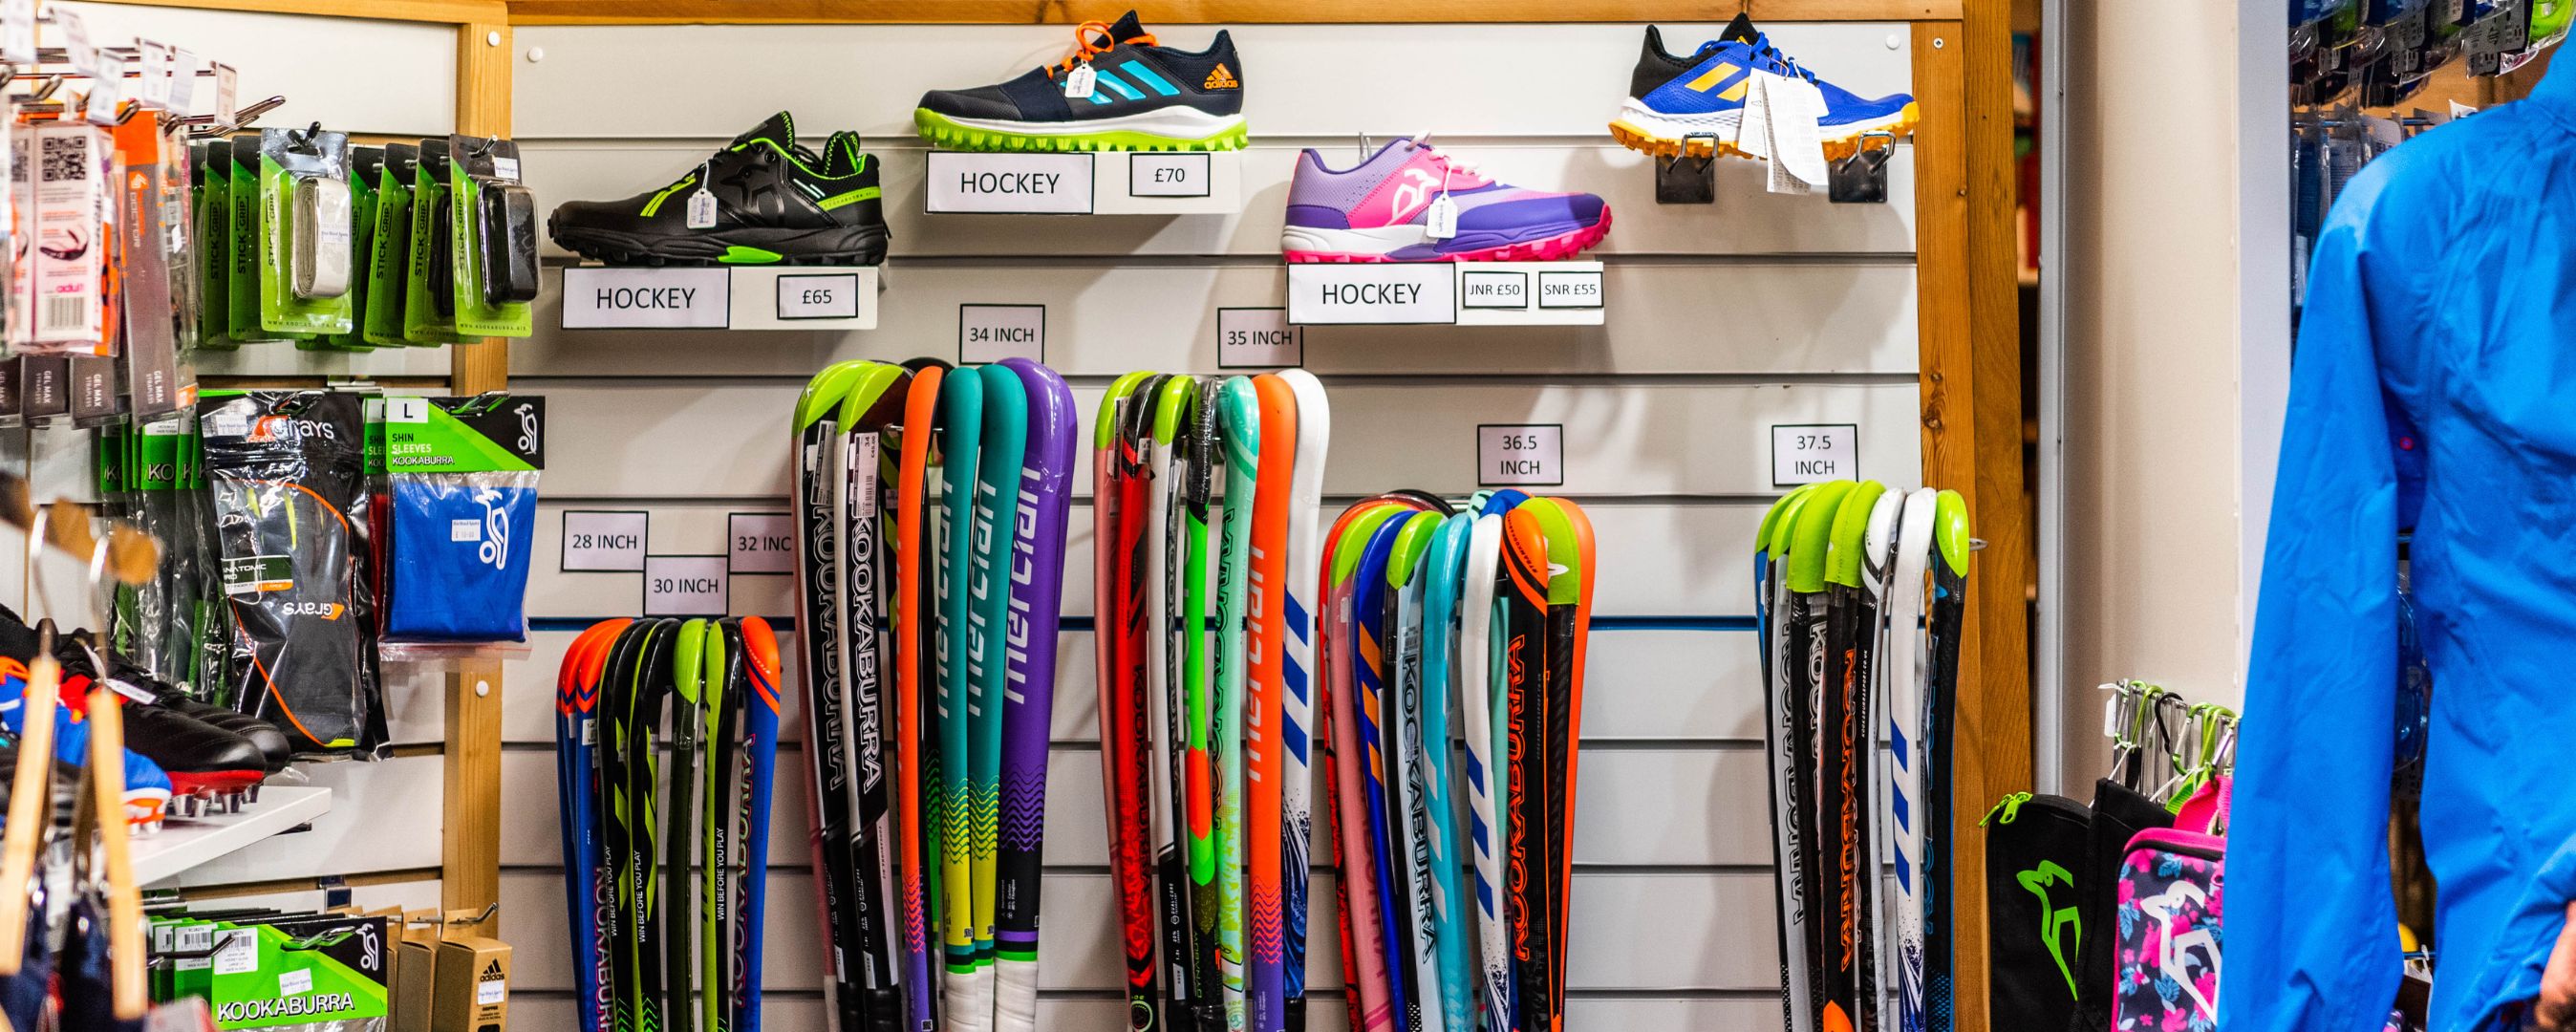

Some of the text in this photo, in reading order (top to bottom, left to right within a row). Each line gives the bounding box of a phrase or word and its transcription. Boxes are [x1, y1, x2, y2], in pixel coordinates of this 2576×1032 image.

[1204, 79, 1238, 90] adidas
[960, 173, 1060, 194] HOCKEY
[1154, 168, 1185, 183] £70
[237, 201, 247, 275] STICK GRIP
[376, 206, 391, 280] STICK GRIP
[415, 204, 428, 277] STICK GRIP
[802, 289, 832, 305] £65
[1321, 283, 1422, 305] HOCKEY
[1470, 284, 1520, 296] JNR £50
[1544, 283, 1597, 295] SNR £55
[596, 287, 696, 310] HOCKEY
[969, 327, 1035, 342] 34 INCH
[1227, 331, 1293, 346] 35 INCH
[43, 387, 52, 404] MAX
[94, 374, 102, 407] GEL MAX
[156, 385, 164, 403] MAX
[404, 403, 414, 419] L
[392, 433, 414, 442] SHIN
[865, 436, 870, 447] 34
[1502, 435, 1537, 450] 36.5
[1796, 436, 1832, 450] 37.5
[392, 443, 432, 455] SLEEVES
[392, 456, 454, 467] KOOKABURRA
[1500, 460, 1540, 475] INCH
[1794, 460, 1835, 476] INCH
[572, 534, 637, 549] 28 INCH
[738, 536, 791, 551] 32 INC
[653, 578, 719, 593] 30 INCH
[1004, 465, 1042, 705] mercian
[967, 480, 998, 717] mercian
[850, 516, 883, 794] KOOKABURRA
[1245, 546, 1264, 784] mercian
[1507, 634, 1529, 961] KOOKABURRA
[736, 733, 756, 1007] KOOKABURRA
[593, 865, 616, 1032] KOOKABUR
[218, 992, 355, 1022] KOOKABURRA
